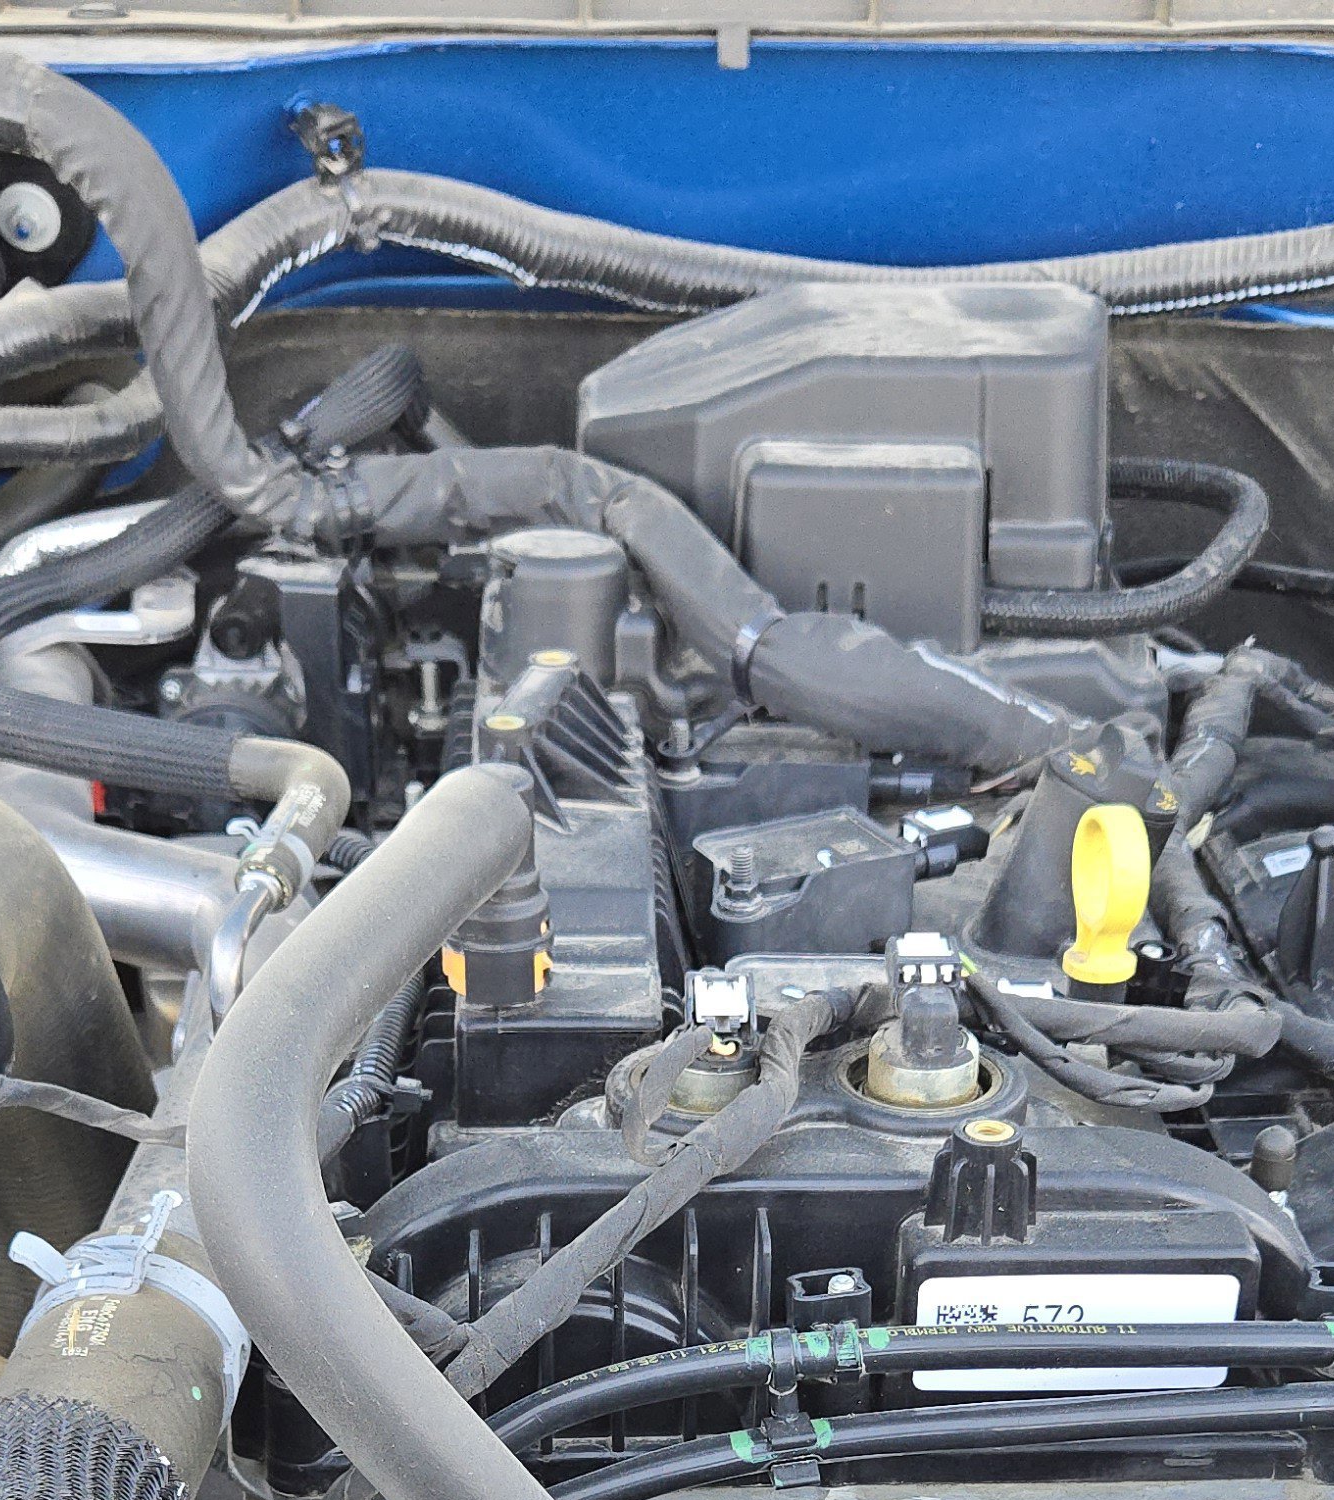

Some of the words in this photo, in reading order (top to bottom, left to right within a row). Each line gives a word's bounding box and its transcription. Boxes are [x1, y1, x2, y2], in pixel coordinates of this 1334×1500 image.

[76, 1310, 99, 1331] ENG
[967, 1324, 998, 1335] MRY
[1005, 1324, 1107, 1335] AUTOMOTIVE
